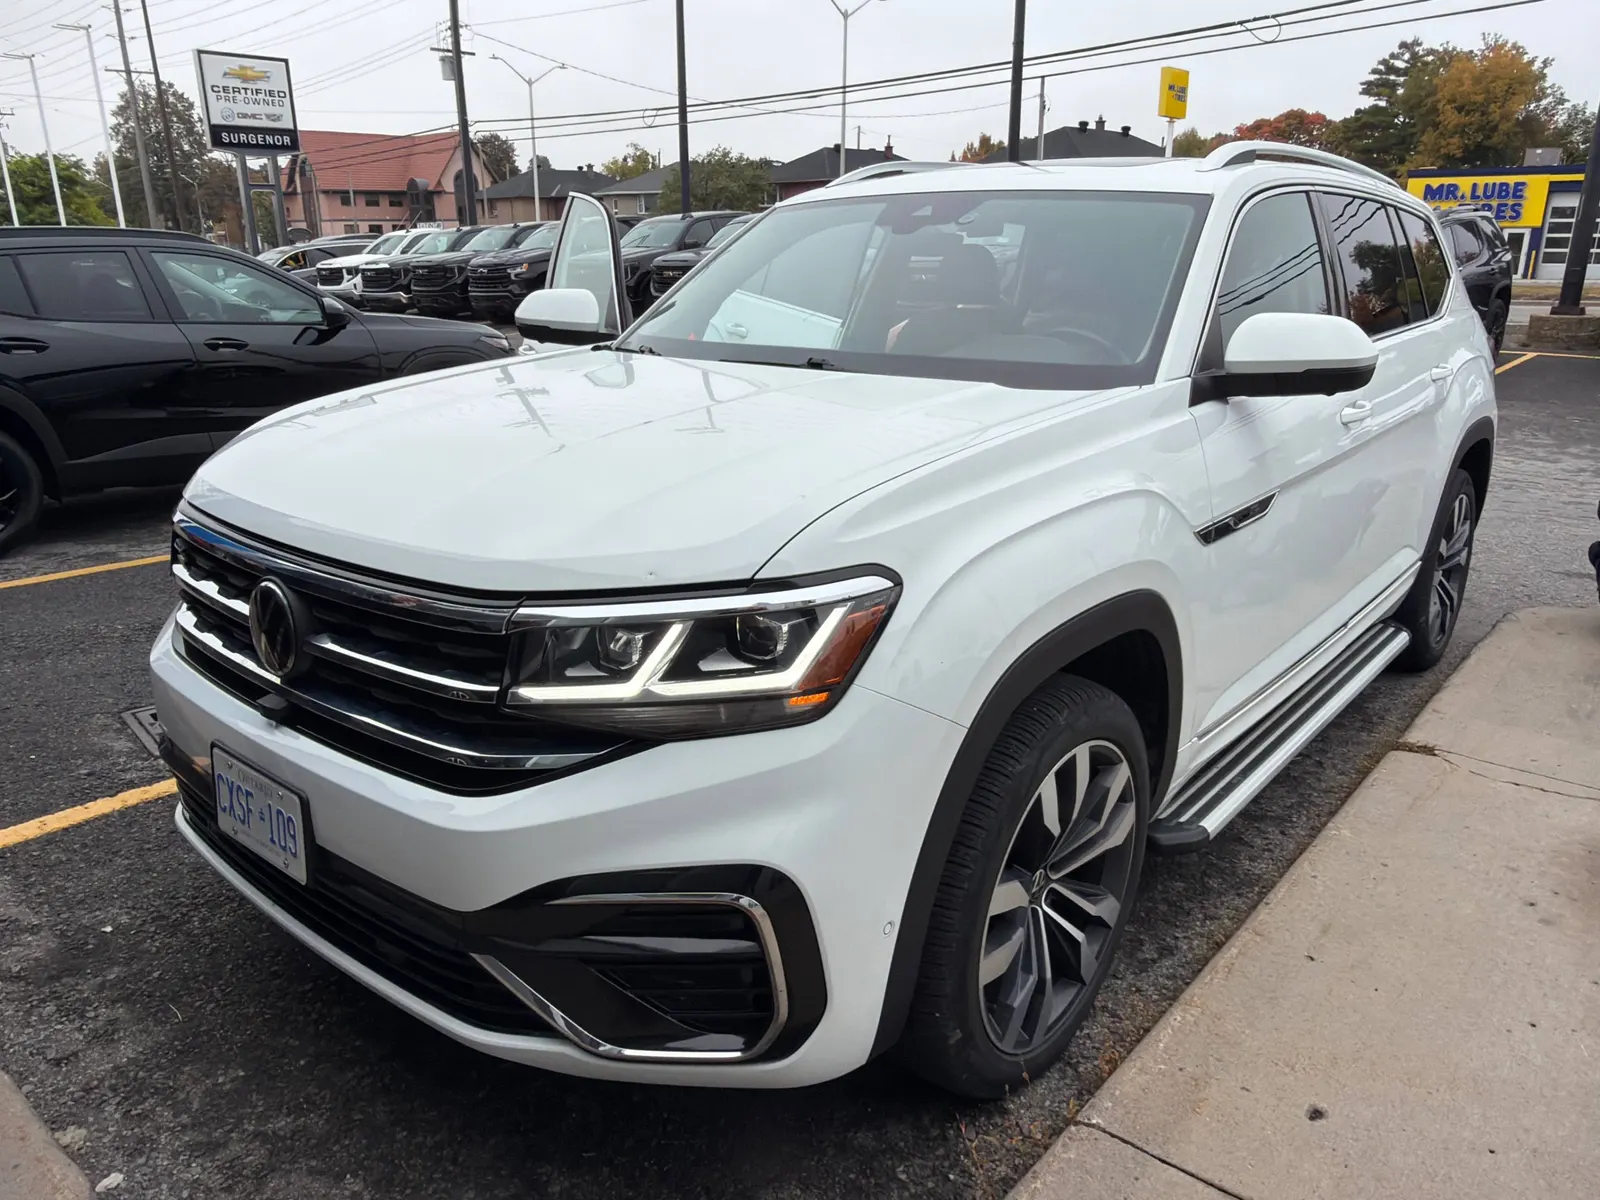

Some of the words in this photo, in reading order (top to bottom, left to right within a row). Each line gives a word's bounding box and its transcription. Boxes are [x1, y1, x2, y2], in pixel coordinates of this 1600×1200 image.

[210, 84, 287, 99] CERTIFIED
[216, 94, 285, 107] PRE-OWNED
[236, 112, 263, 120] GMC
[221, 132, 291, 146] SURGENOR
[1423, 183, 1467, 201] MR.
[1470, 181, 1527, 201] LUBE
[216, 771, 255, 830] CXSF
[267, 801, 298, 858] 109
